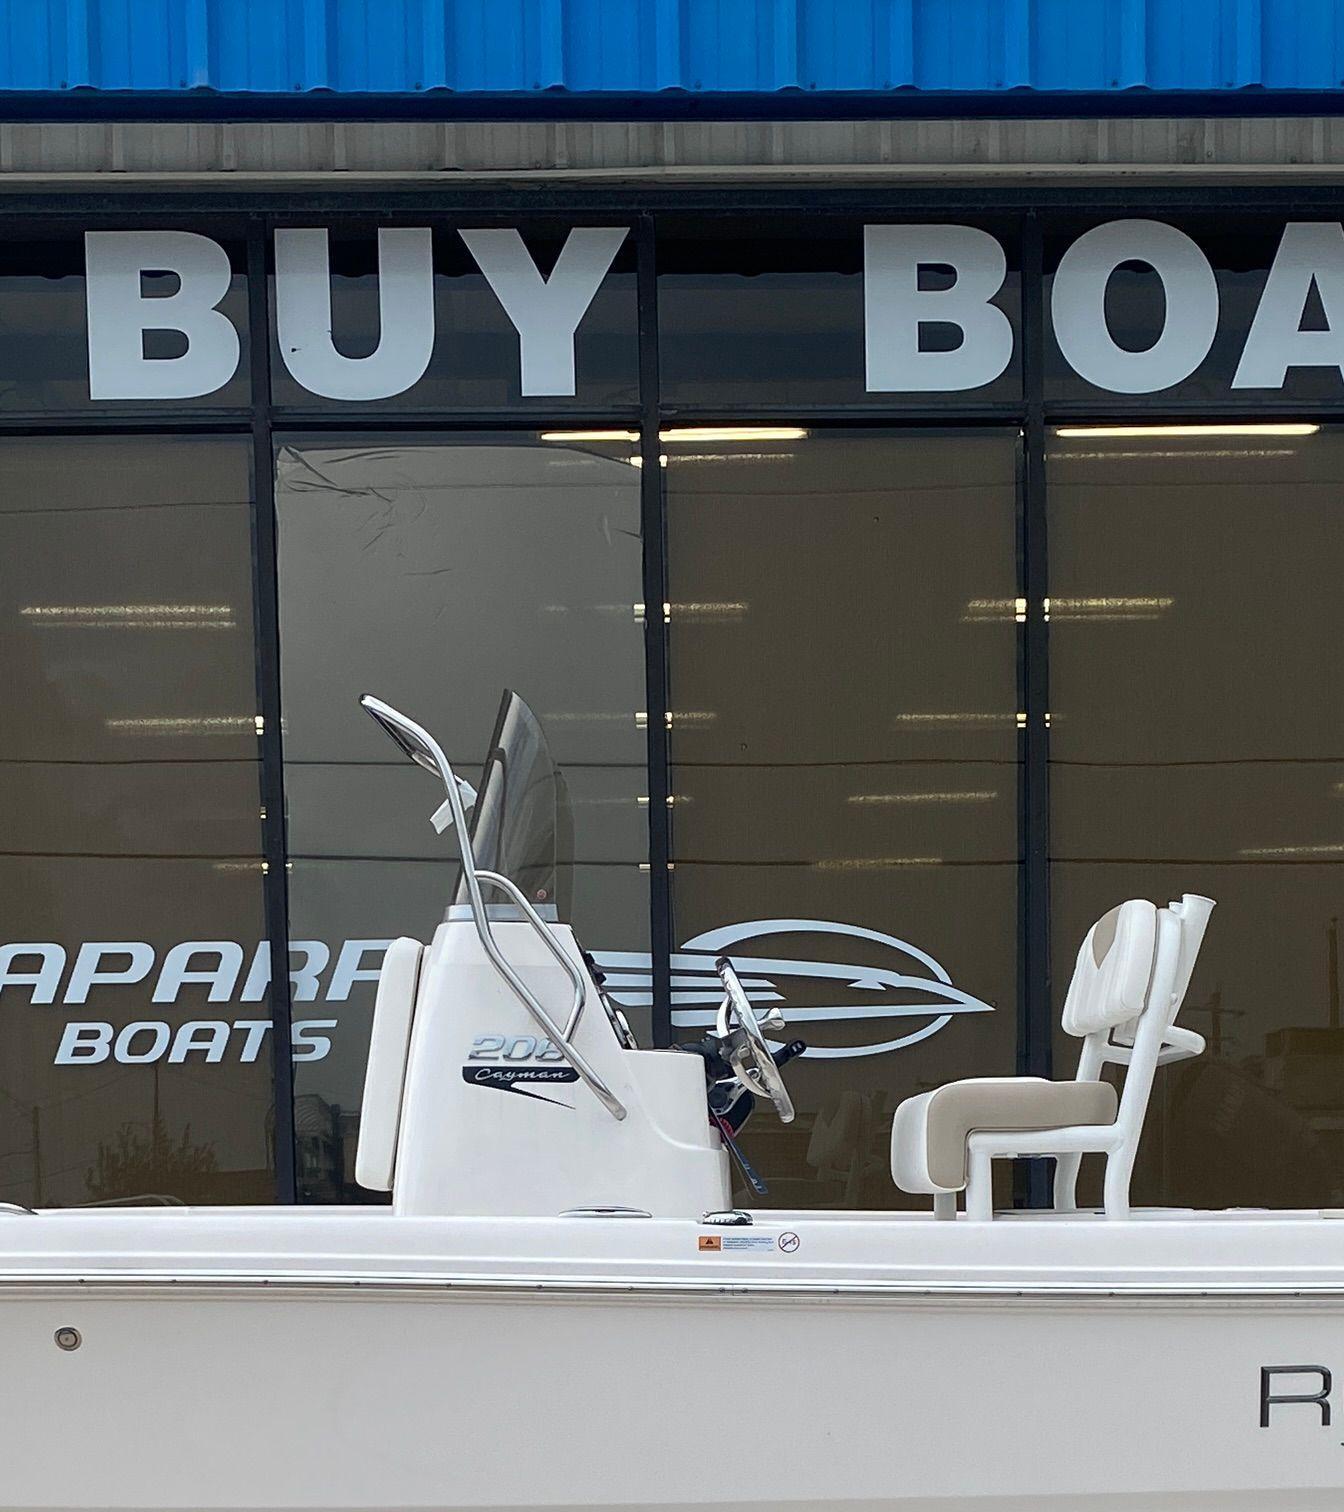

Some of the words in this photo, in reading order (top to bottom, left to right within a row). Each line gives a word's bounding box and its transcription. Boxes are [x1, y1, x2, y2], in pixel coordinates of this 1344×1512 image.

[84, 227, 630, 401] BUY
[54, 1019, 338, 1065] BOATS
[474, 1068, 571, 1082] Cayman
